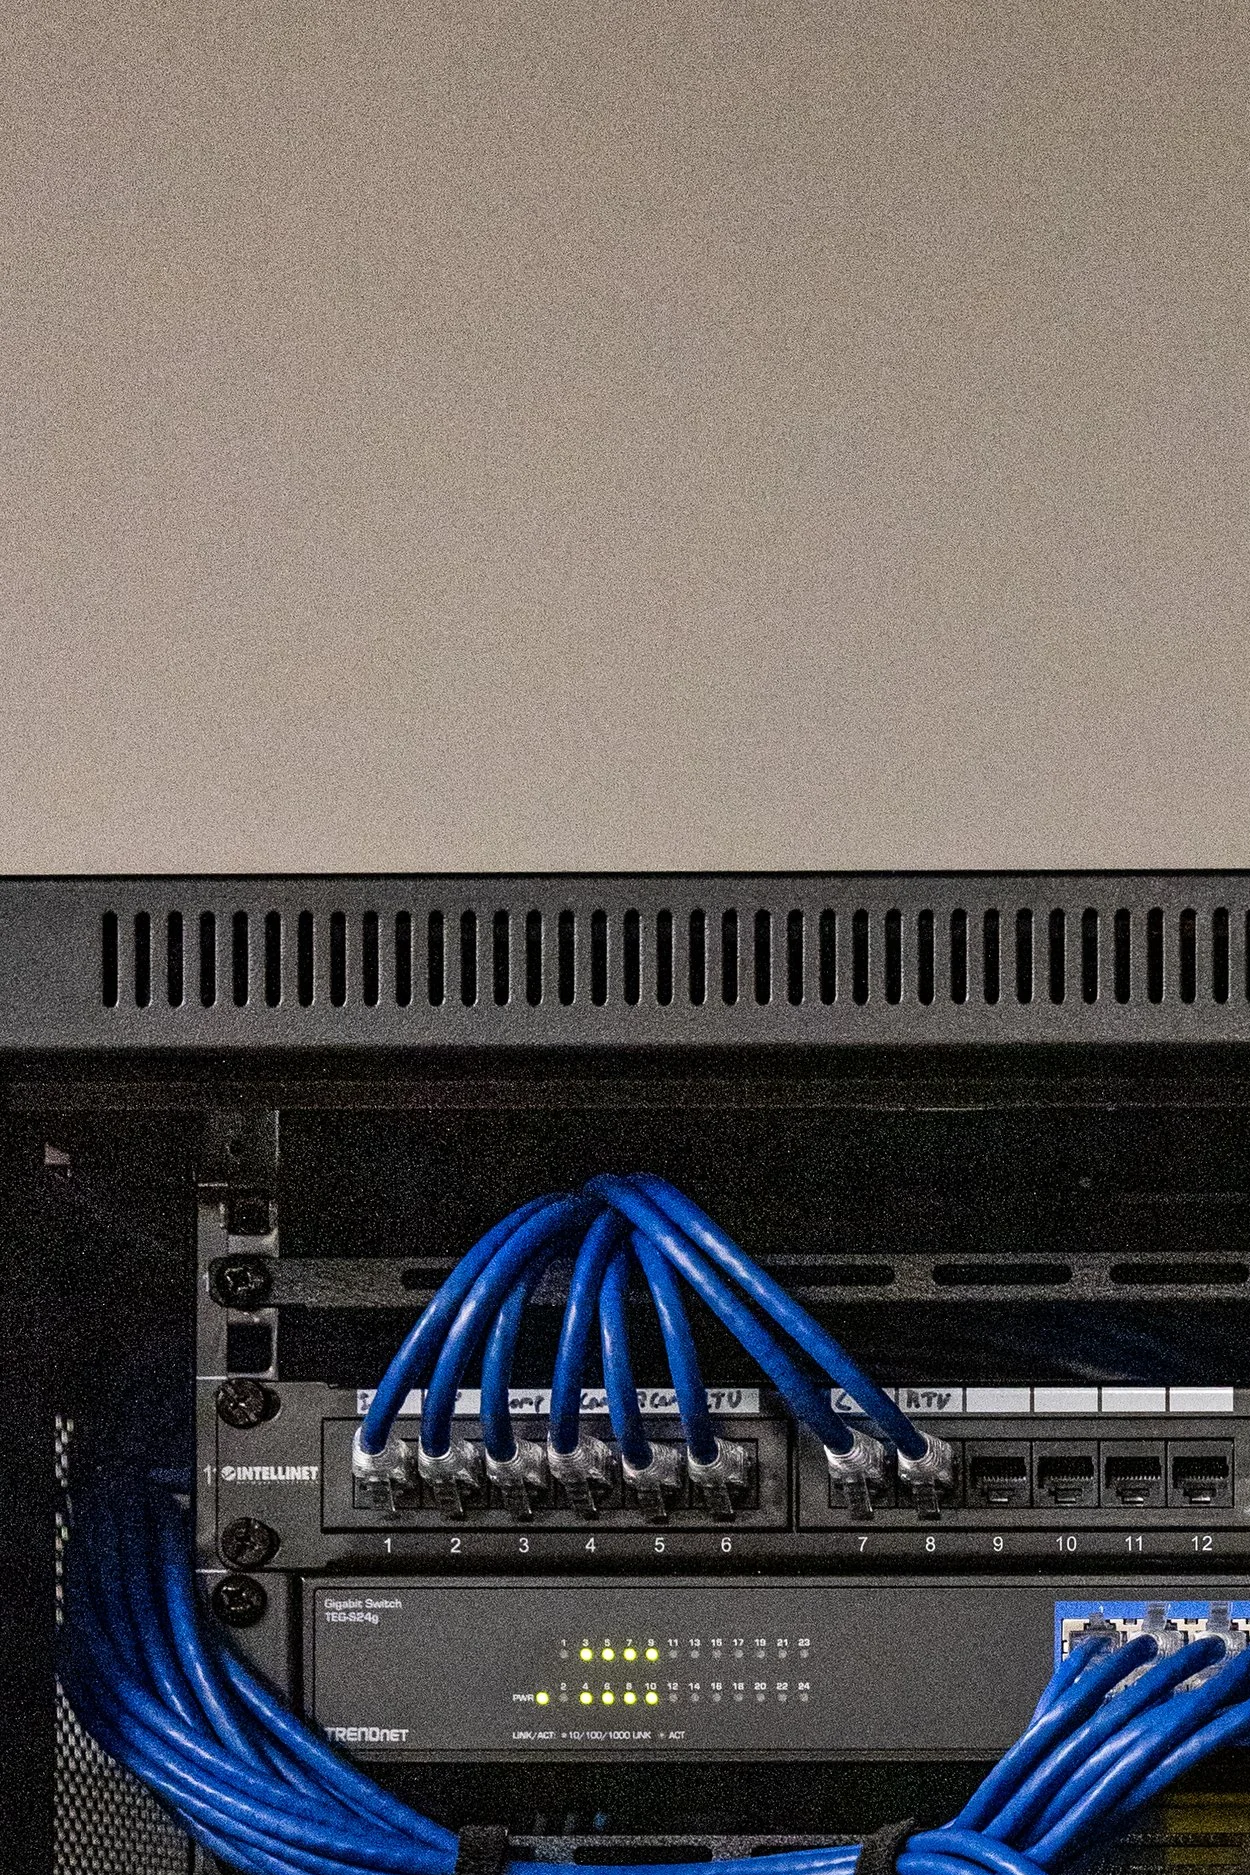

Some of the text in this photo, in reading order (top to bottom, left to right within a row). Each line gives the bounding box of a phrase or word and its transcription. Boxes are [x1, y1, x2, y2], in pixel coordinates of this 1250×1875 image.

[906, 1390, 951, 1410] RTV
[237, 1466, 318, 1480] INTELLINET
[383, 1537, 392, 1553] 1
[450, 1537, 462, 1554] 2
[518, 1536, 530, 1554] 3
[584, 1537, 596, 1553] 4
[654, 1536, 666, 1553] 5
[720, 1536, 732, 1553] 6
[857, 1535, 869, 1552] 7
[925, 1535, 937, 1553] 8
[992, 1535, 1004, 1552] 9
[1056, 1535, 1078, 1552] 10
[1125, 1535, 1143, 1552] 11
[1191, 1534, 1213, 1552] 12
[324, 1599, 363, 1610] Gigabit
[560, 1638, 567, 1647] 1
[582, 1638, 590, 1647] 3
[604, 1638, 611, 1647] 5
[626, 1638, 633, 1647] 7
[647, 1638, 655, 1647] 9
[667, 1638, 679, 1647] 11
[689, 1638, 701, 1647] 13
[732, 1638, 745, 1647] 17
[754, 1638, 767, 1647] 19
[776, 1638, 789, 1647] 21
[798, 1638, 811, 1647] 23
[560, 1682, 567, 1691] 2
[582, 1682, 589, 1690] 4
[644, 1682, 657, 1691] 10
[667, 1682, 679, 1691] 12
[688, 1682, 701, 1690] 14
[732, 1682, 745, 1691] 18
[754, 1682, 767, 1691] 20
[776, 1682, 789, 1691] 22
[798, 1682, 811, 1691] 24
[512, 1694, 534, 1702] PWR
[668, 1731, 686, 1740] ACT
